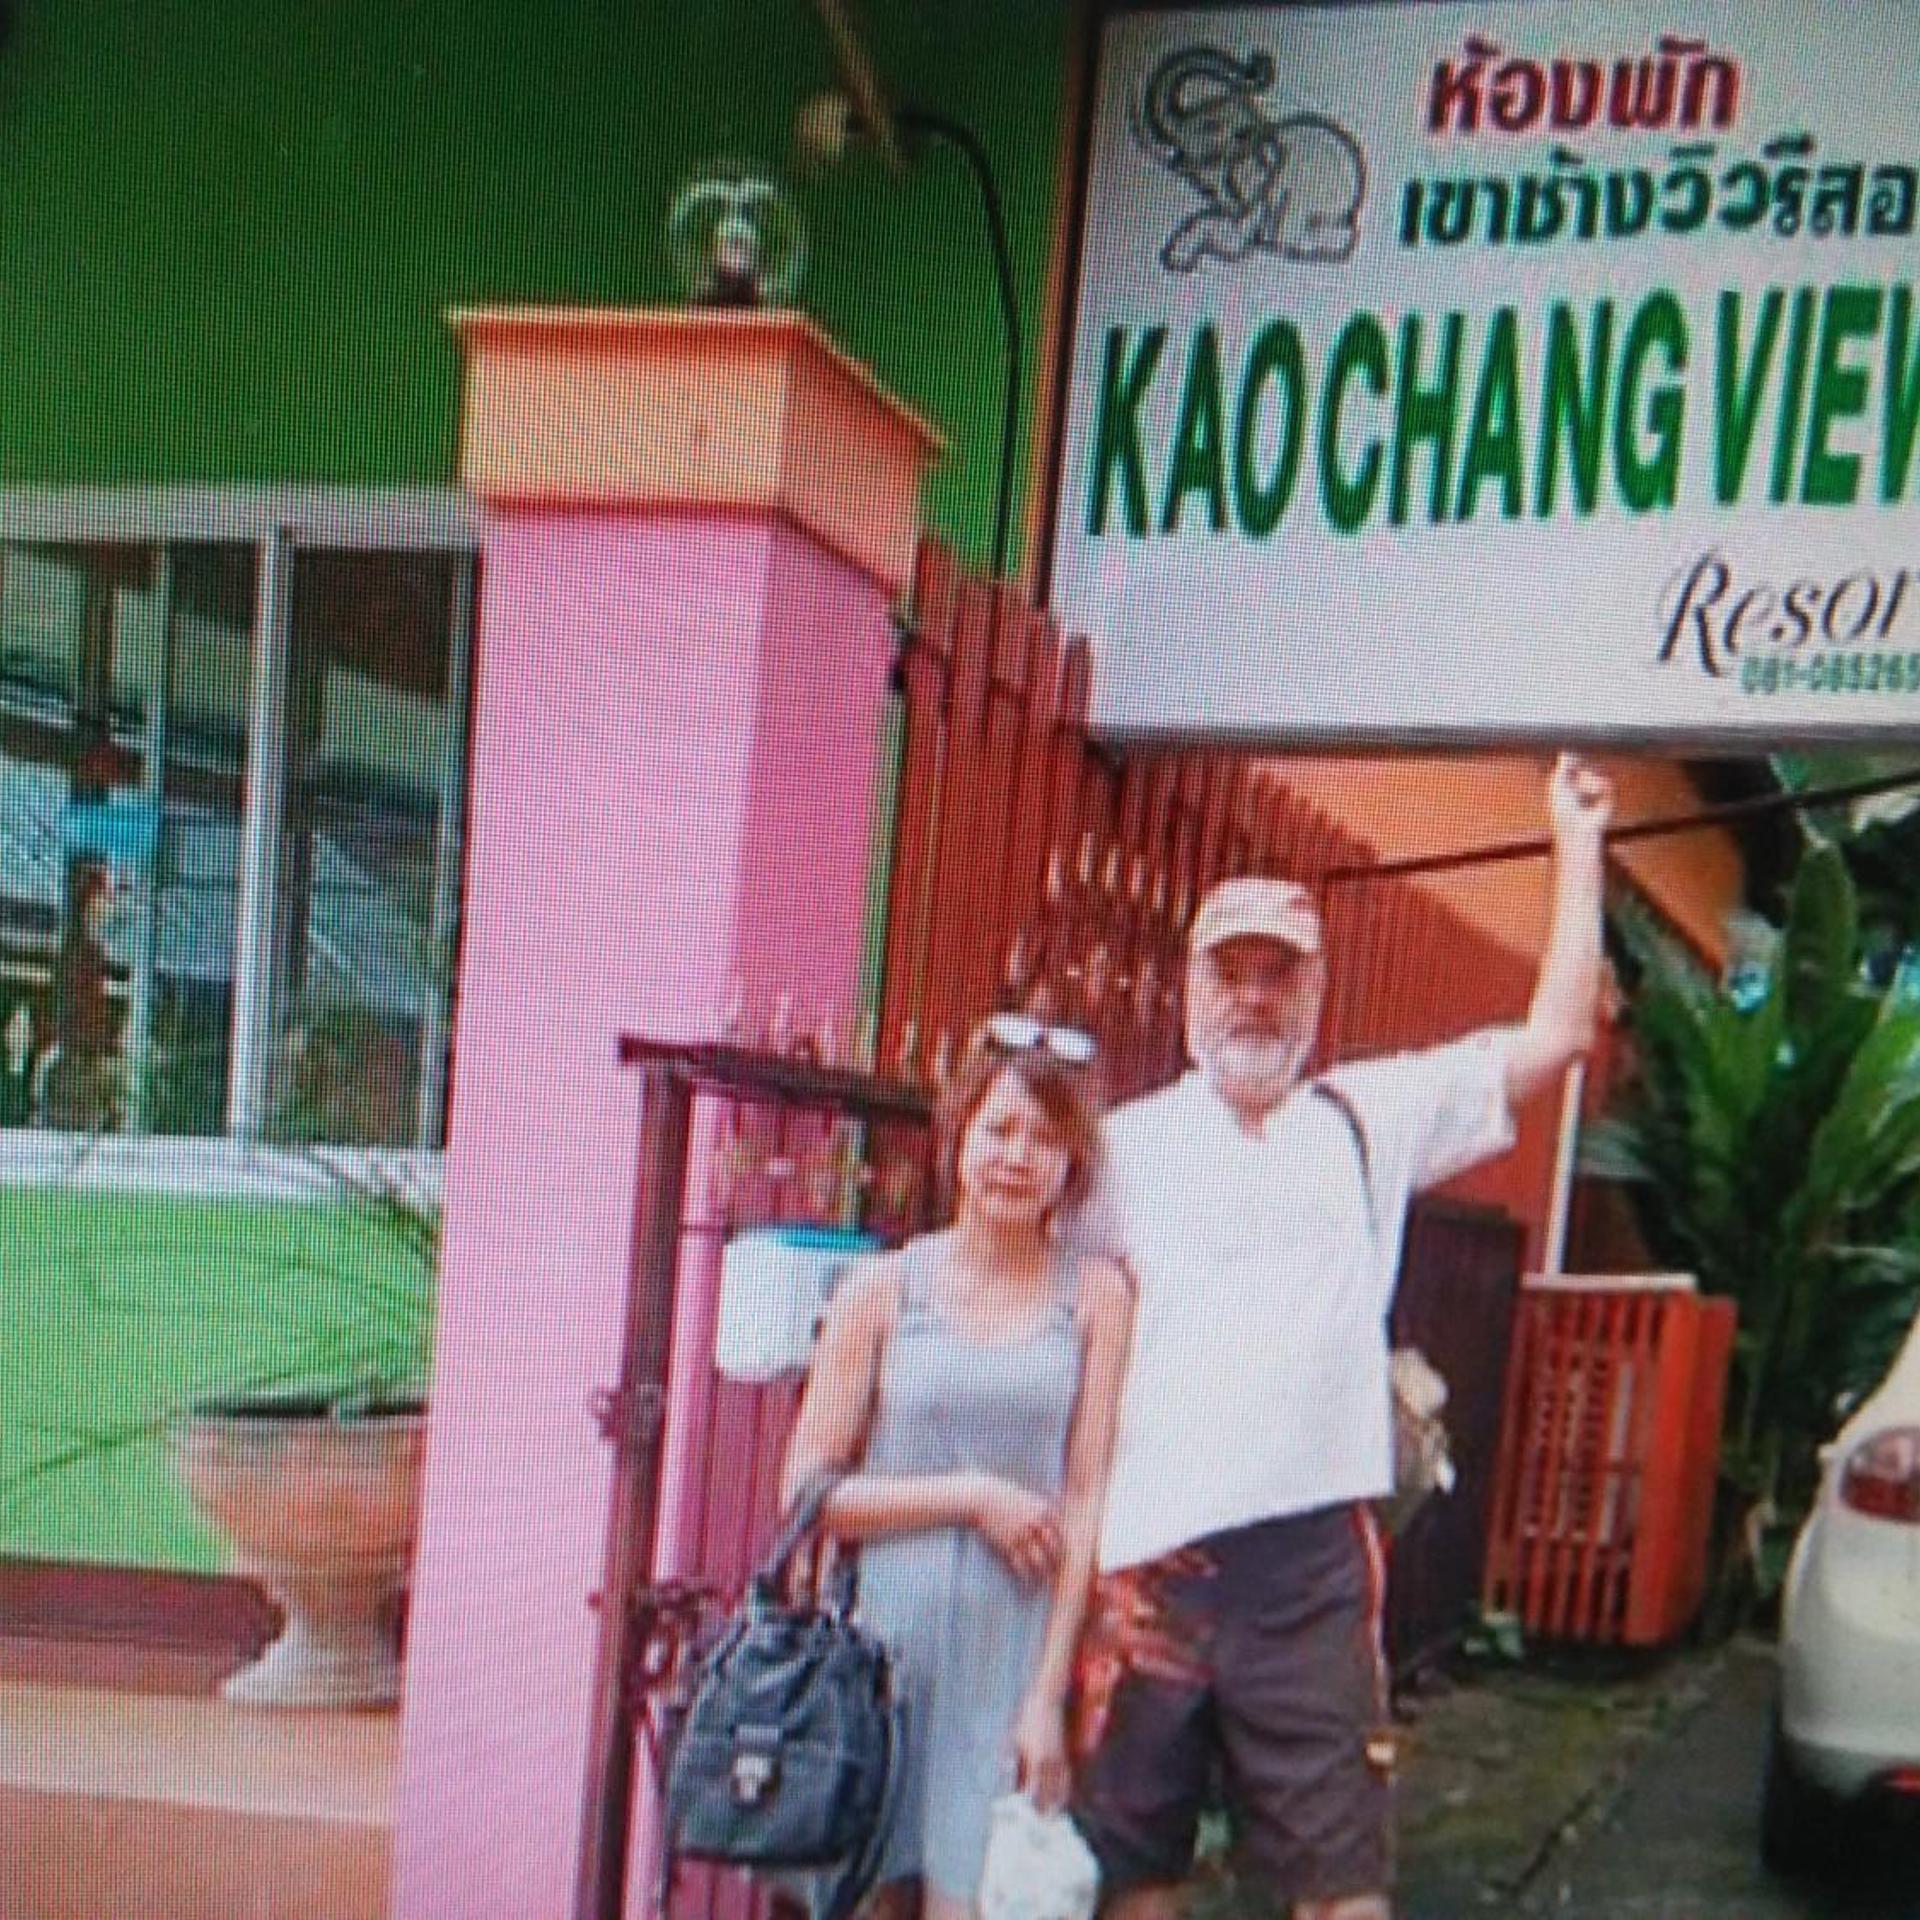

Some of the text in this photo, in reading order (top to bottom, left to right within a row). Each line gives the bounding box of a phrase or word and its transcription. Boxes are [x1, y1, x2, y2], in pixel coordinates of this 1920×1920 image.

[1428, 36, 1740, 132] ห้องพัก
[1087, 288, 1690, 540] KAOCHANG
